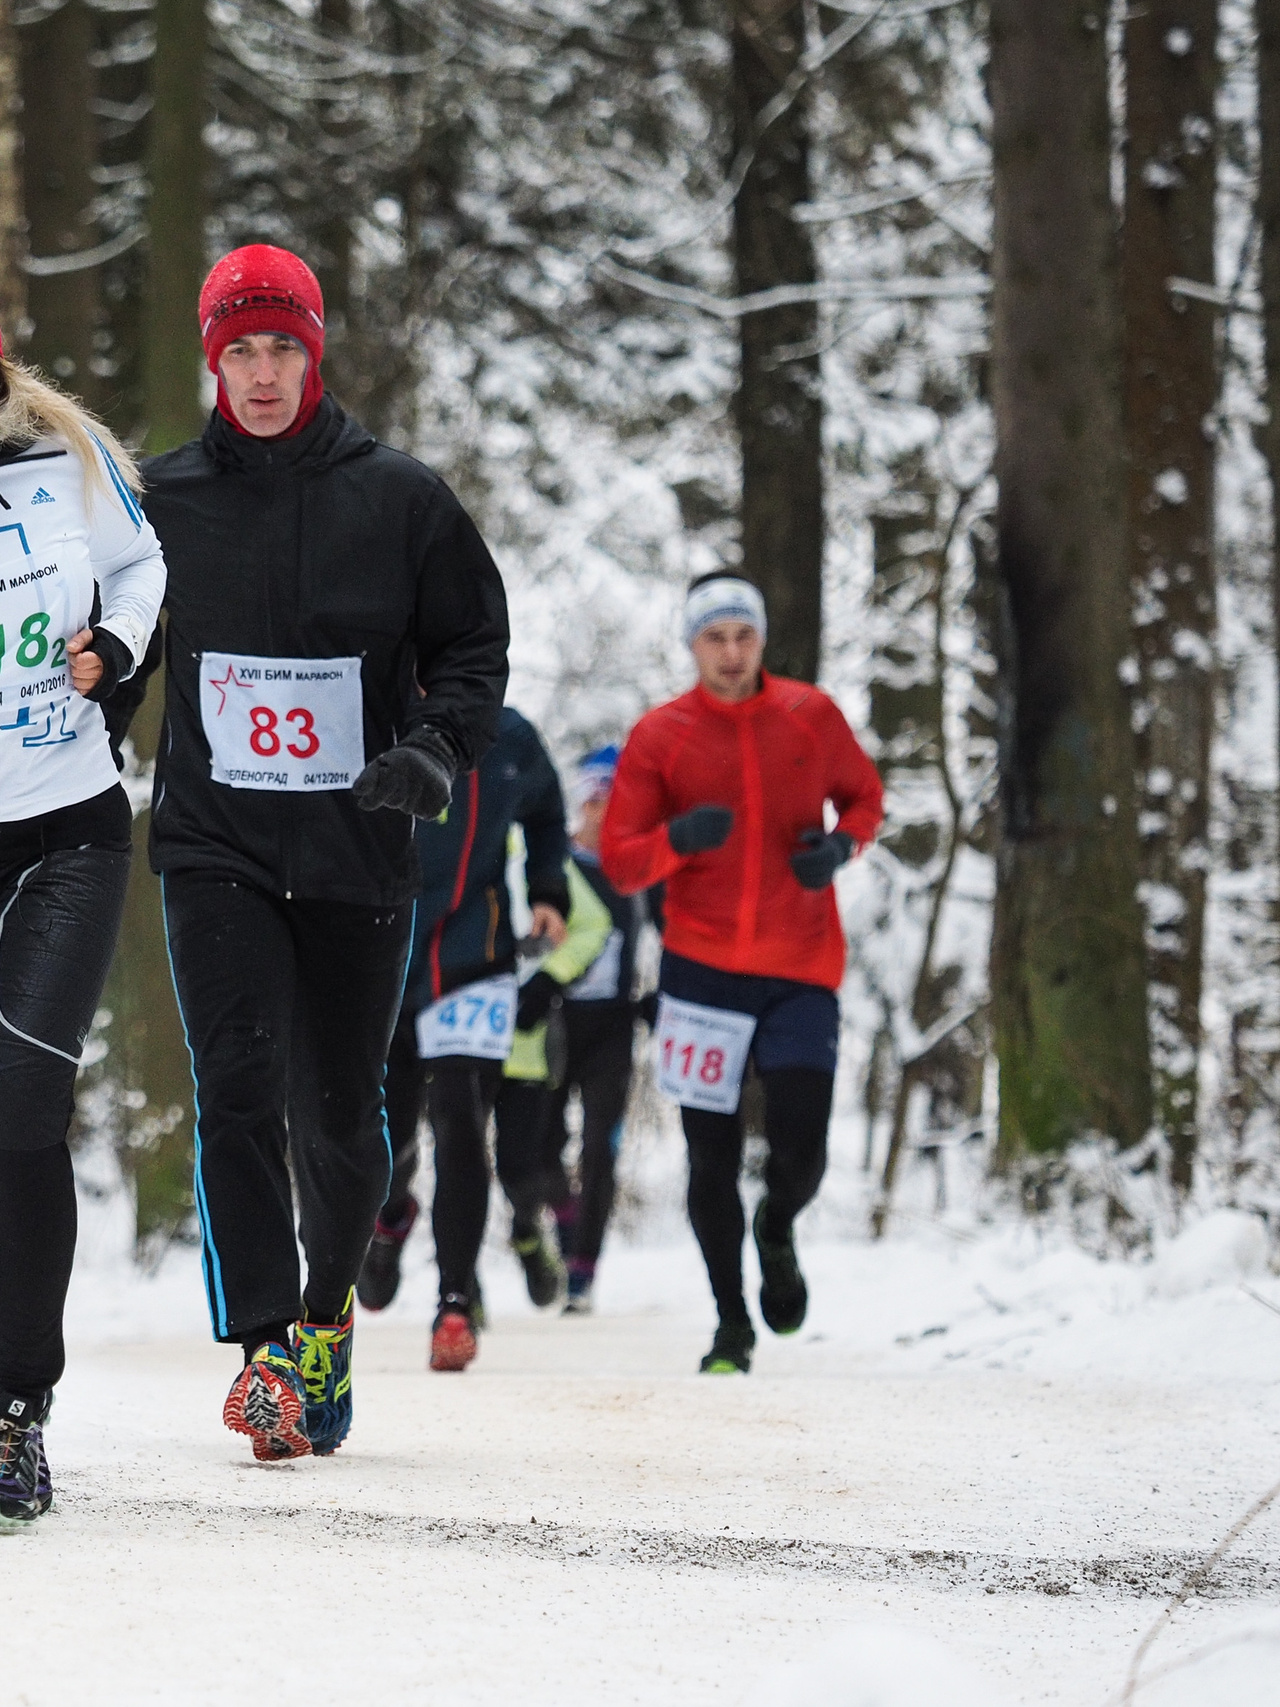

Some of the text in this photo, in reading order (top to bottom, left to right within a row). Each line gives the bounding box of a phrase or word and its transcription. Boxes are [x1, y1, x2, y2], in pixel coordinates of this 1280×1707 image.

[31, 497, 56, 505] adidas
[9, 563, 59, 589] МАРАФОН
[20, 674, 66, 698] 04/12/2016
[240, 668, 344, 681] XVII БИМ МАРАФОН
[250, 706, 320, 759] 83
[303, 772, 350, 785] 04/12/2016
[439, 997, 508, 1034] 476
[663, 1039, 724, 1085] 118
